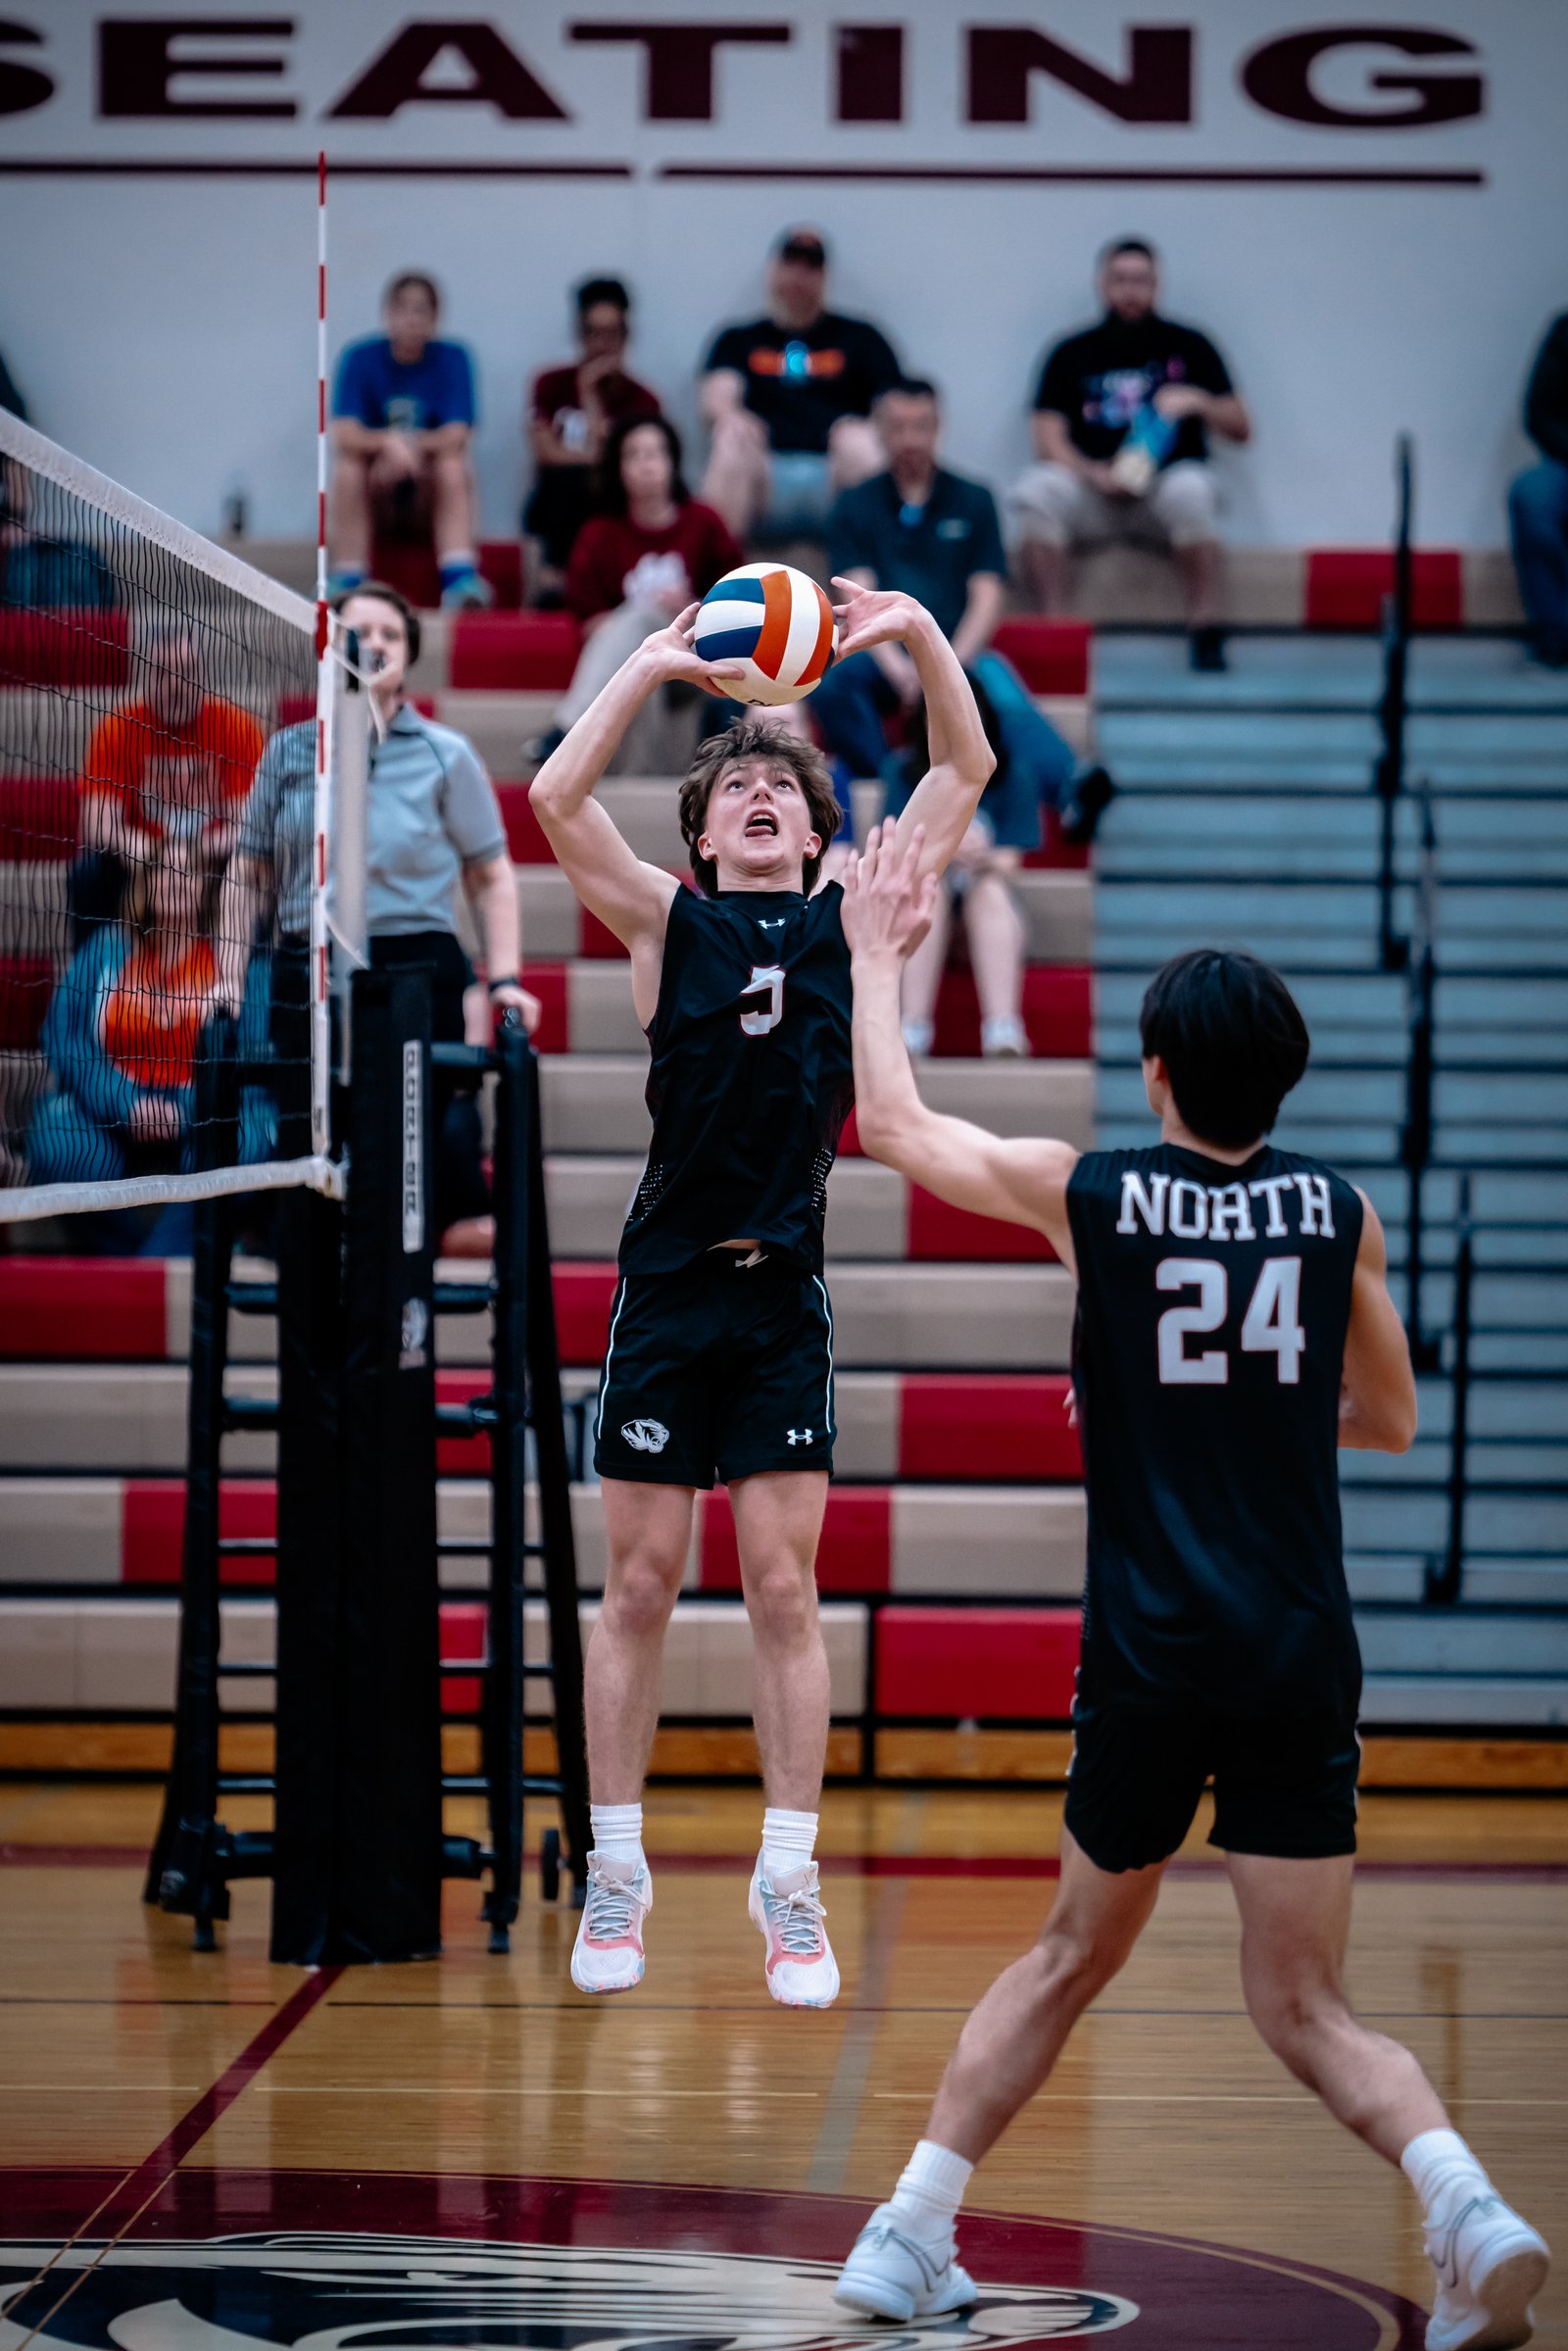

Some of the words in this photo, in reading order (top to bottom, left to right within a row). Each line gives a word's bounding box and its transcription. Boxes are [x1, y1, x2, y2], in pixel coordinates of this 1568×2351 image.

[405, 1048, 416, 1216] PORTER
[1115, 1170, 1337, 1242] NORTH
[1155, 1255, 1305, 1385] 24
